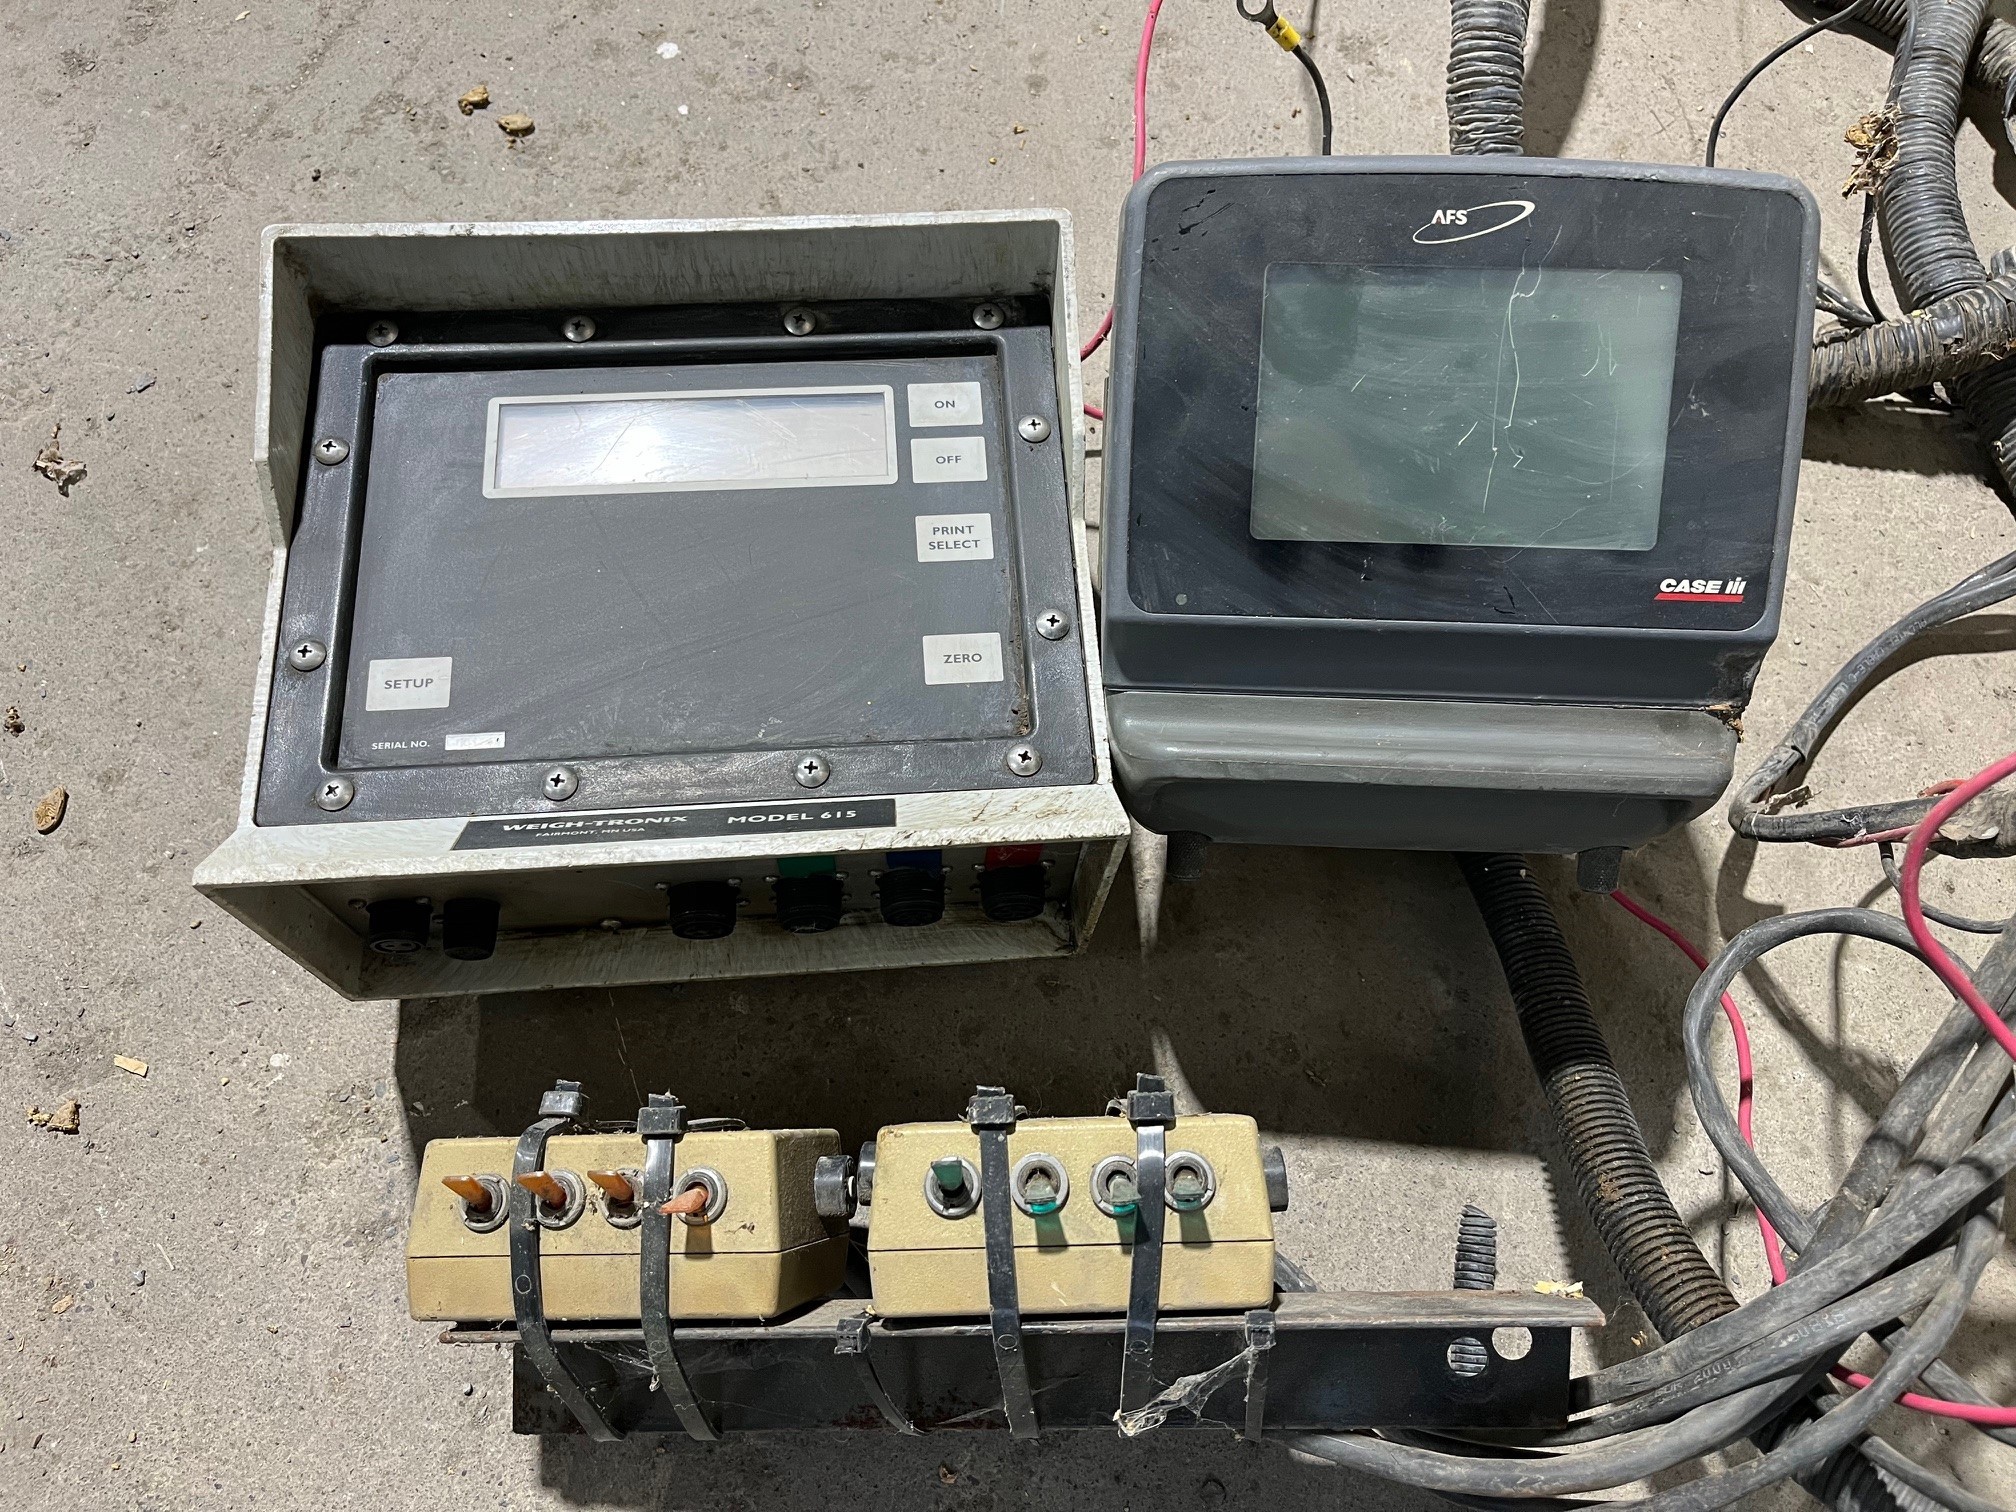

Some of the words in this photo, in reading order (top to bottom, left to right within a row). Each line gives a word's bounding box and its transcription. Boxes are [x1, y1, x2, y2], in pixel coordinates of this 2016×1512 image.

[1431, 209, 1468, 226] AFS
[934, 400, 956, 409] ON
[935, 455, 962, 464] OFF
[932, 525, 975, 536] PRINT
[928, 539, 980, 550] SELECT
[1659, 578, 1723, 594] CASE
[943, 652, 983, 664] ZERO
[384, 678, 434, 690] SETUP
[371, 740, 408, 750] SERIAL
[410, 740, 430, 748] NO.
[502, 815, 689, 832] WEIGH-TRONIX
[727, 812, 814, 824] MODEL
[820, 810, 857, 819] 615
